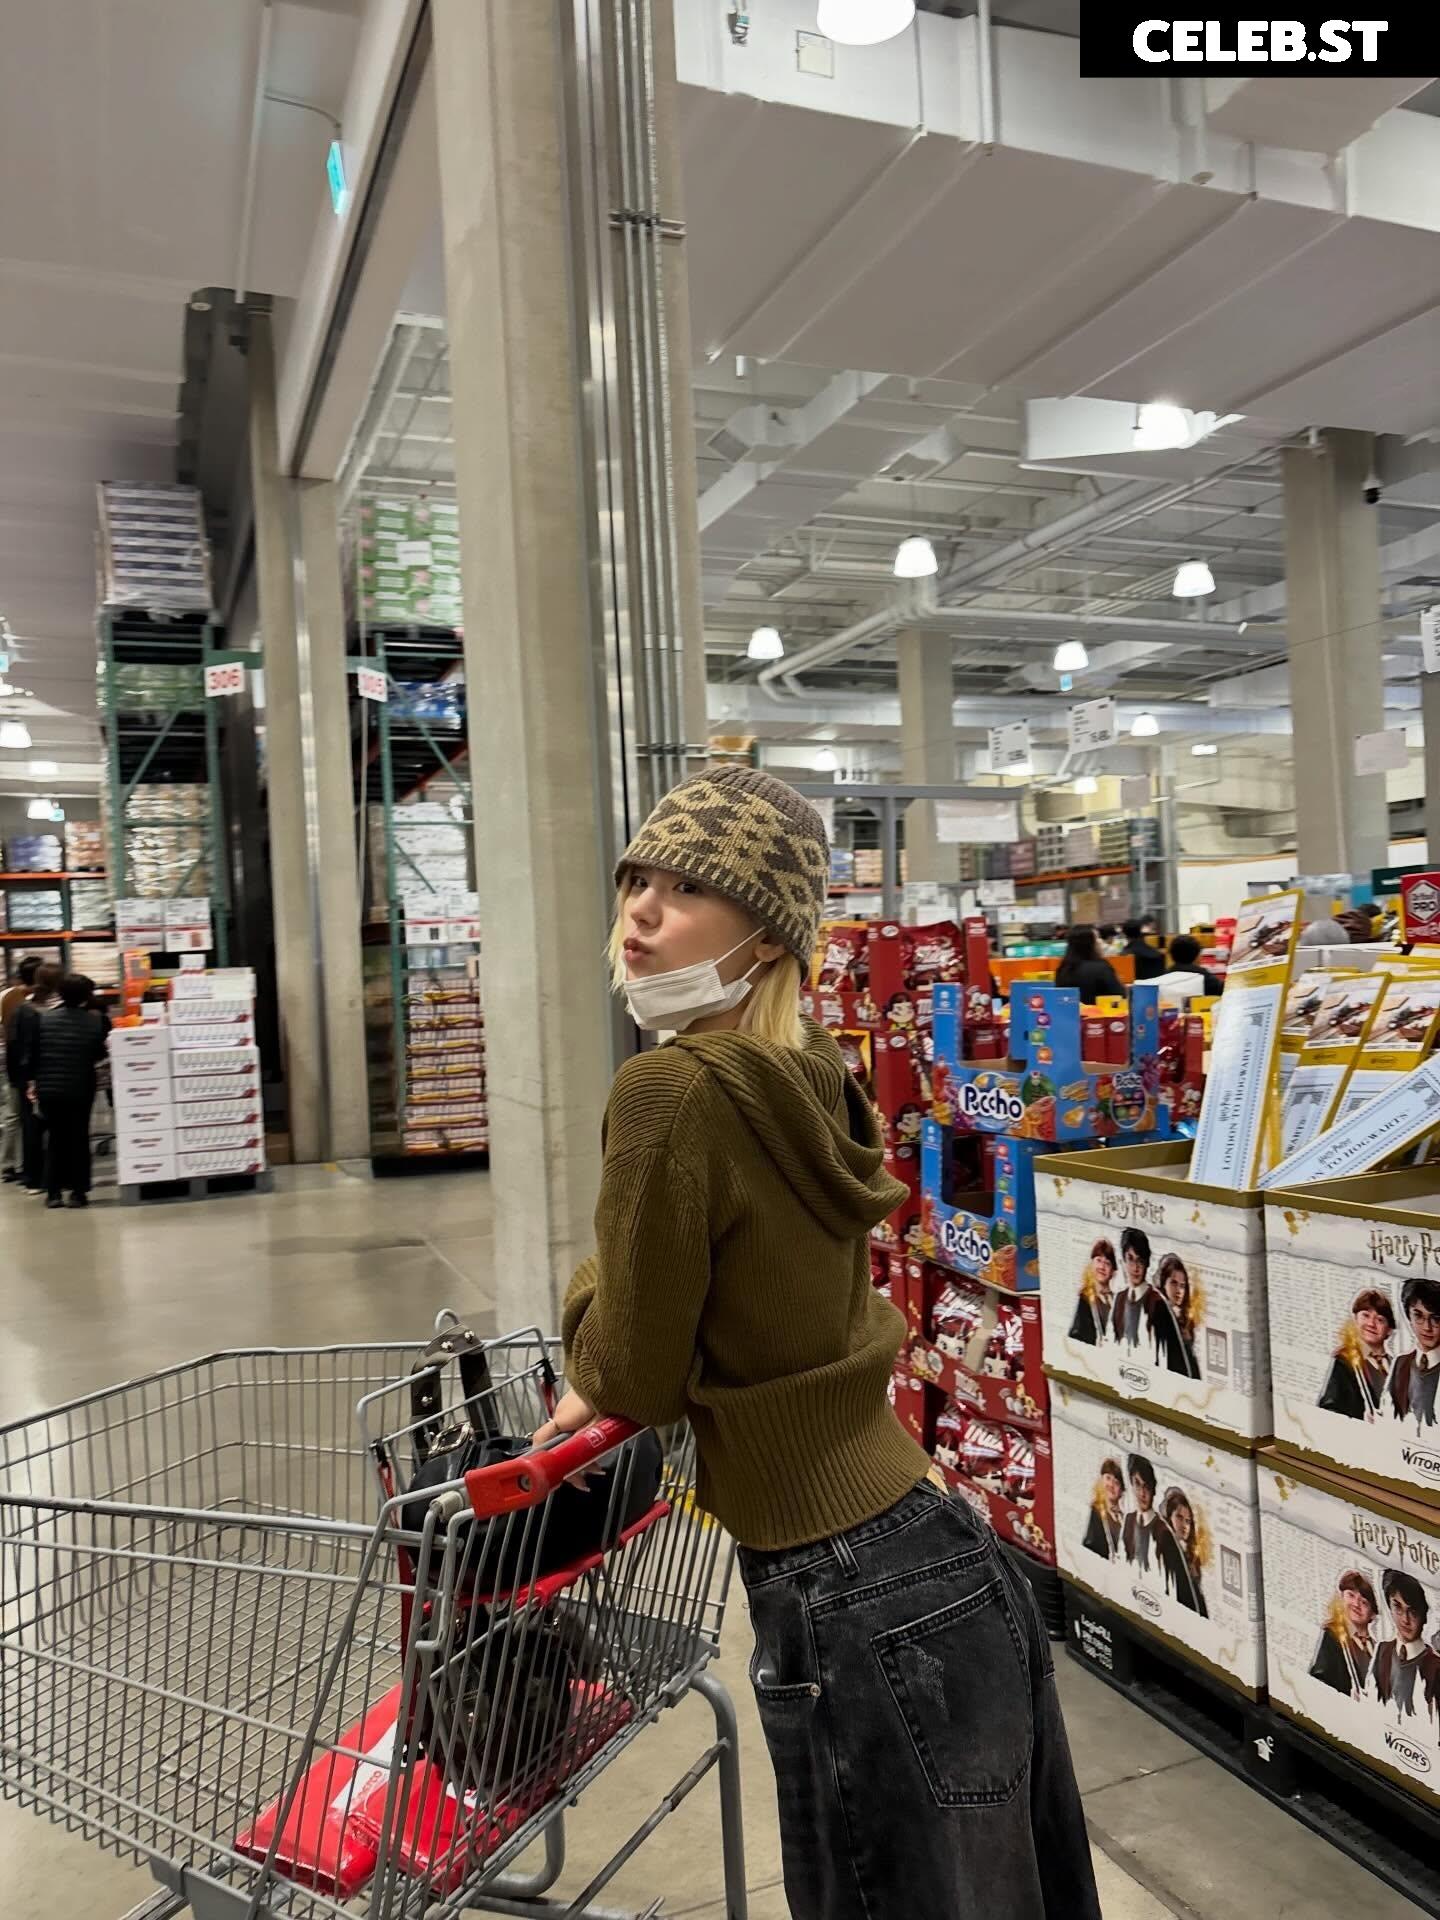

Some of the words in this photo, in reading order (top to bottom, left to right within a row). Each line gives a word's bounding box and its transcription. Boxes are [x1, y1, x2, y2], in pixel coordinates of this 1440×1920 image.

[962, 1084, 1024, 1120] Puccho
[1222, 1122, 1238, 1170] LONDON
[1231, 1104, 1241, 1119] TO
[1327, 1156, 1342, 1169] TO
[1344, 1112, 1409, 1158] HOGWARTS
[1100, 1190, 1130, 1219] Harry
[1130, 1191, 1166, 1225] Potter
[943, 1221, 992, 1263] Puccho
[1367, 1229, 1420, 1266] Harry
[1106, 1410, 1135, 1444] Harry
[1134, 1418, 1168, 1456] Potter
[1350, 1513, 1396, 1556] Harry
[1384, 1731, 1427, 1768] WITOR'S
